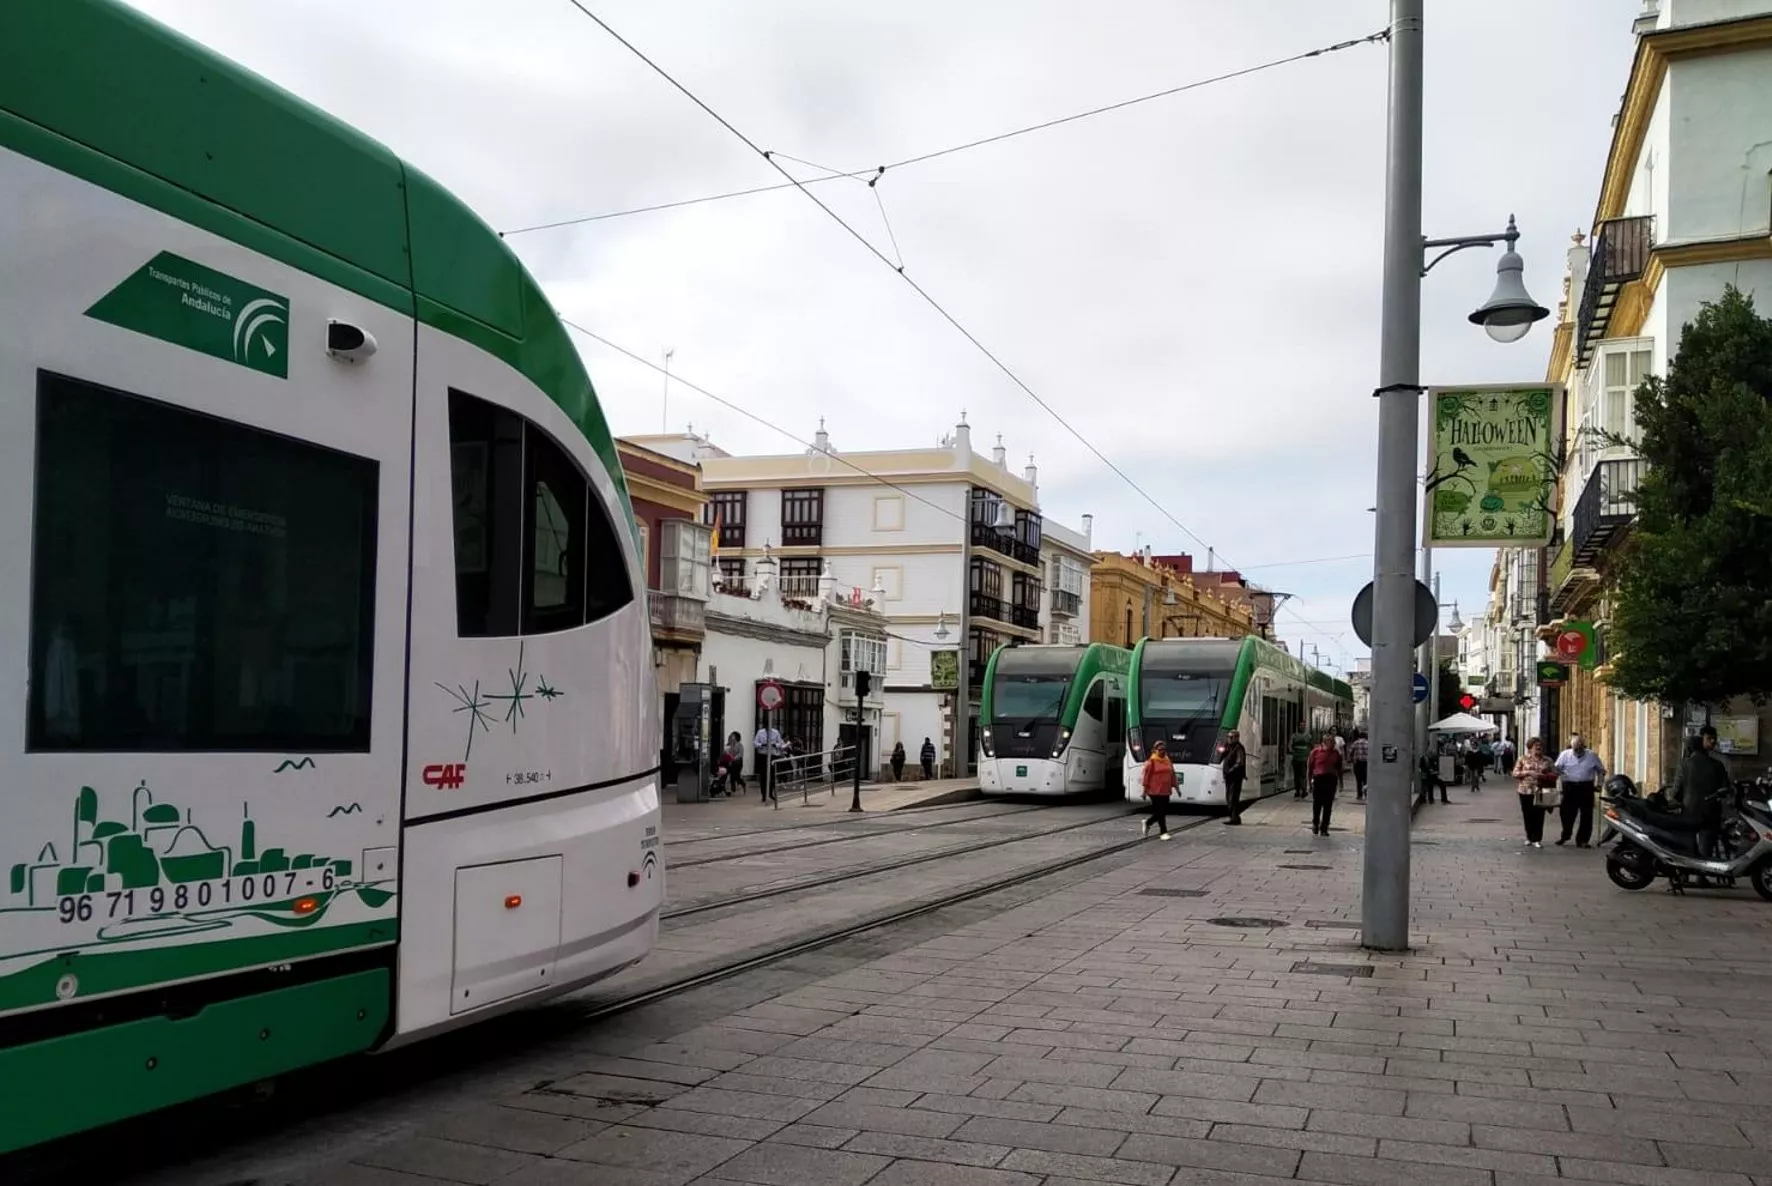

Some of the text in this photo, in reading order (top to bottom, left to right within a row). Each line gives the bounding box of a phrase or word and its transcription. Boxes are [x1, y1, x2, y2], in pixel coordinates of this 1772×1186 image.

[149, 266, 190, 290] Transportes
[222, 295, 232, 305] de
[1450, 415, 1538, 446] HALLOWEEN
[422, 763, 466, 790] CAF
[59, 893, 93, 924] 96
[105, 889, 134, 918] 71
